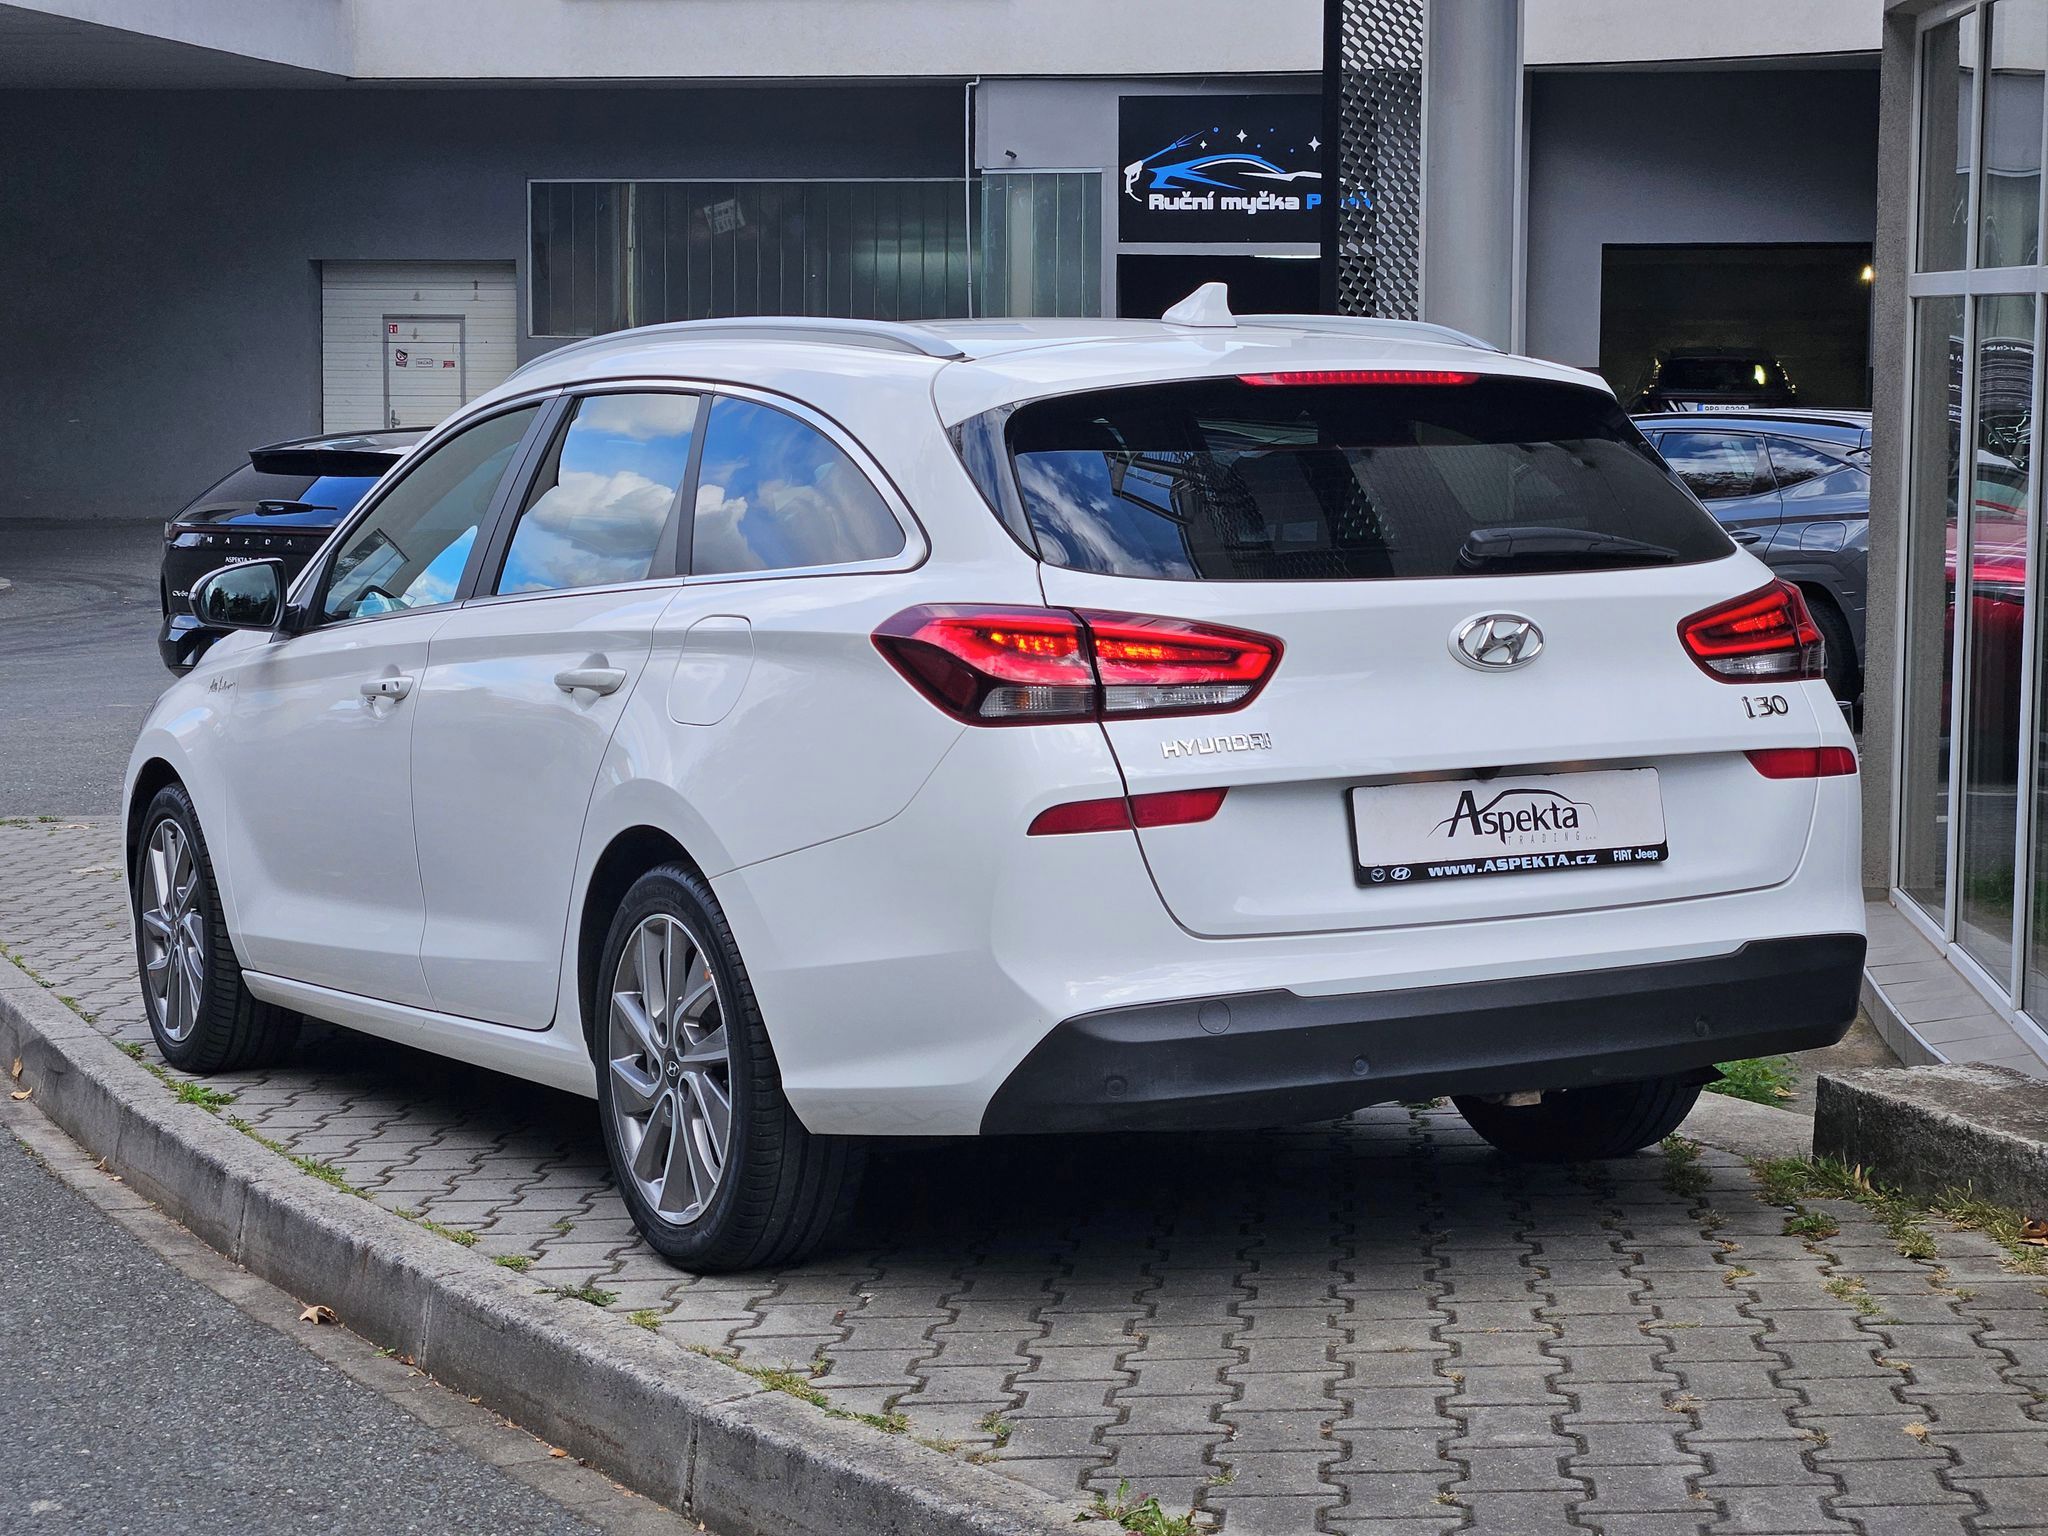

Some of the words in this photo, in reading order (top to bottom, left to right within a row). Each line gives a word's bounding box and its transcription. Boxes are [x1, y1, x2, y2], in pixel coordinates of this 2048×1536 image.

[1149, 191, 1215, 210] Ruční
[1221, 190, 1300, 215] myčka
[206, 536, 292, 546] MAZDA
[1160, 733, 1272, 758] HYUNDAI
[1447, 789, 1580, 846] Aspekta
[1508, 831, 1580, 846] TRADING
[1428, 853, 1598, 878] www.ASPEKTA.cz
[1613, 850, 1632, 863] FIAT
[1635, 849, 1659, 861] Jeep
